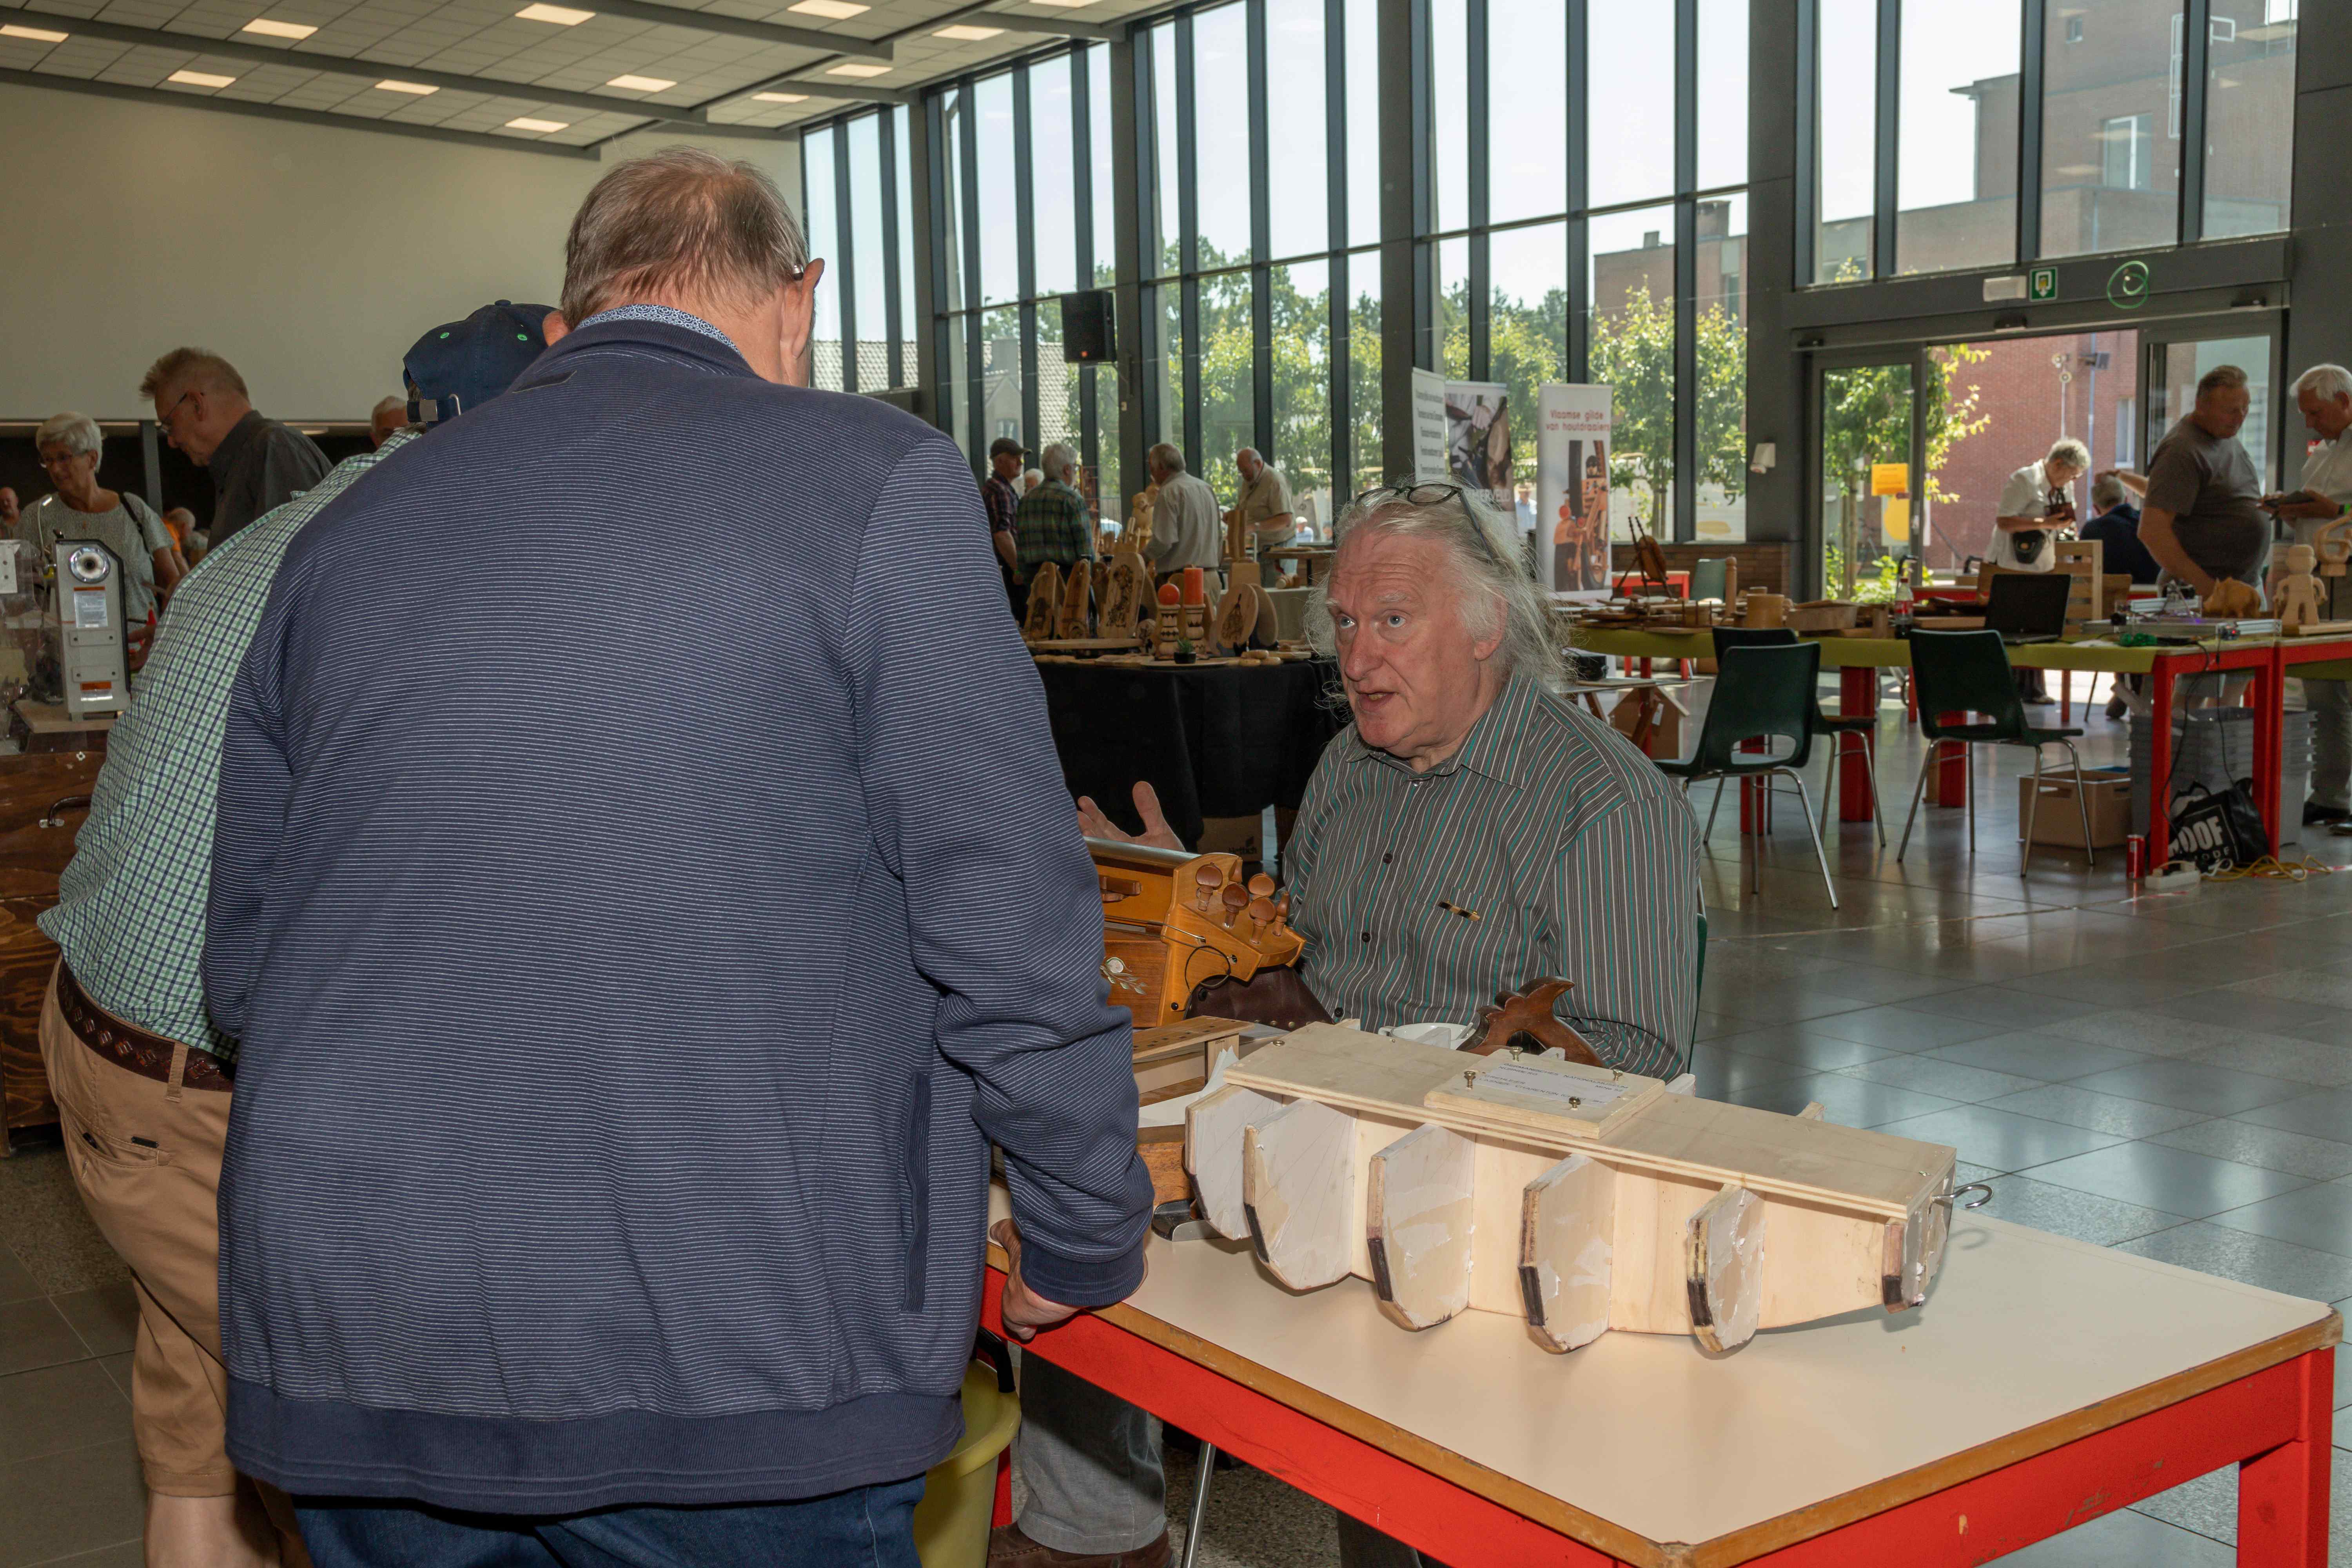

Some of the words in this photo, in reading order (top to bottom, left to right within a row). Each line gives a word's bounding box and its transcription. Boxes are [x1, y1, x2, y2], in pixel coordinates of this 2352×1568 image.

[1550, 409, 1581, 419] Vlaamse
[1585, 409, 1604, 421] gilde
[1563, 1074, 1628, 1089] NATIONALMUSEUM
[1515, 1085, 1559, 1096] CHARENTON
